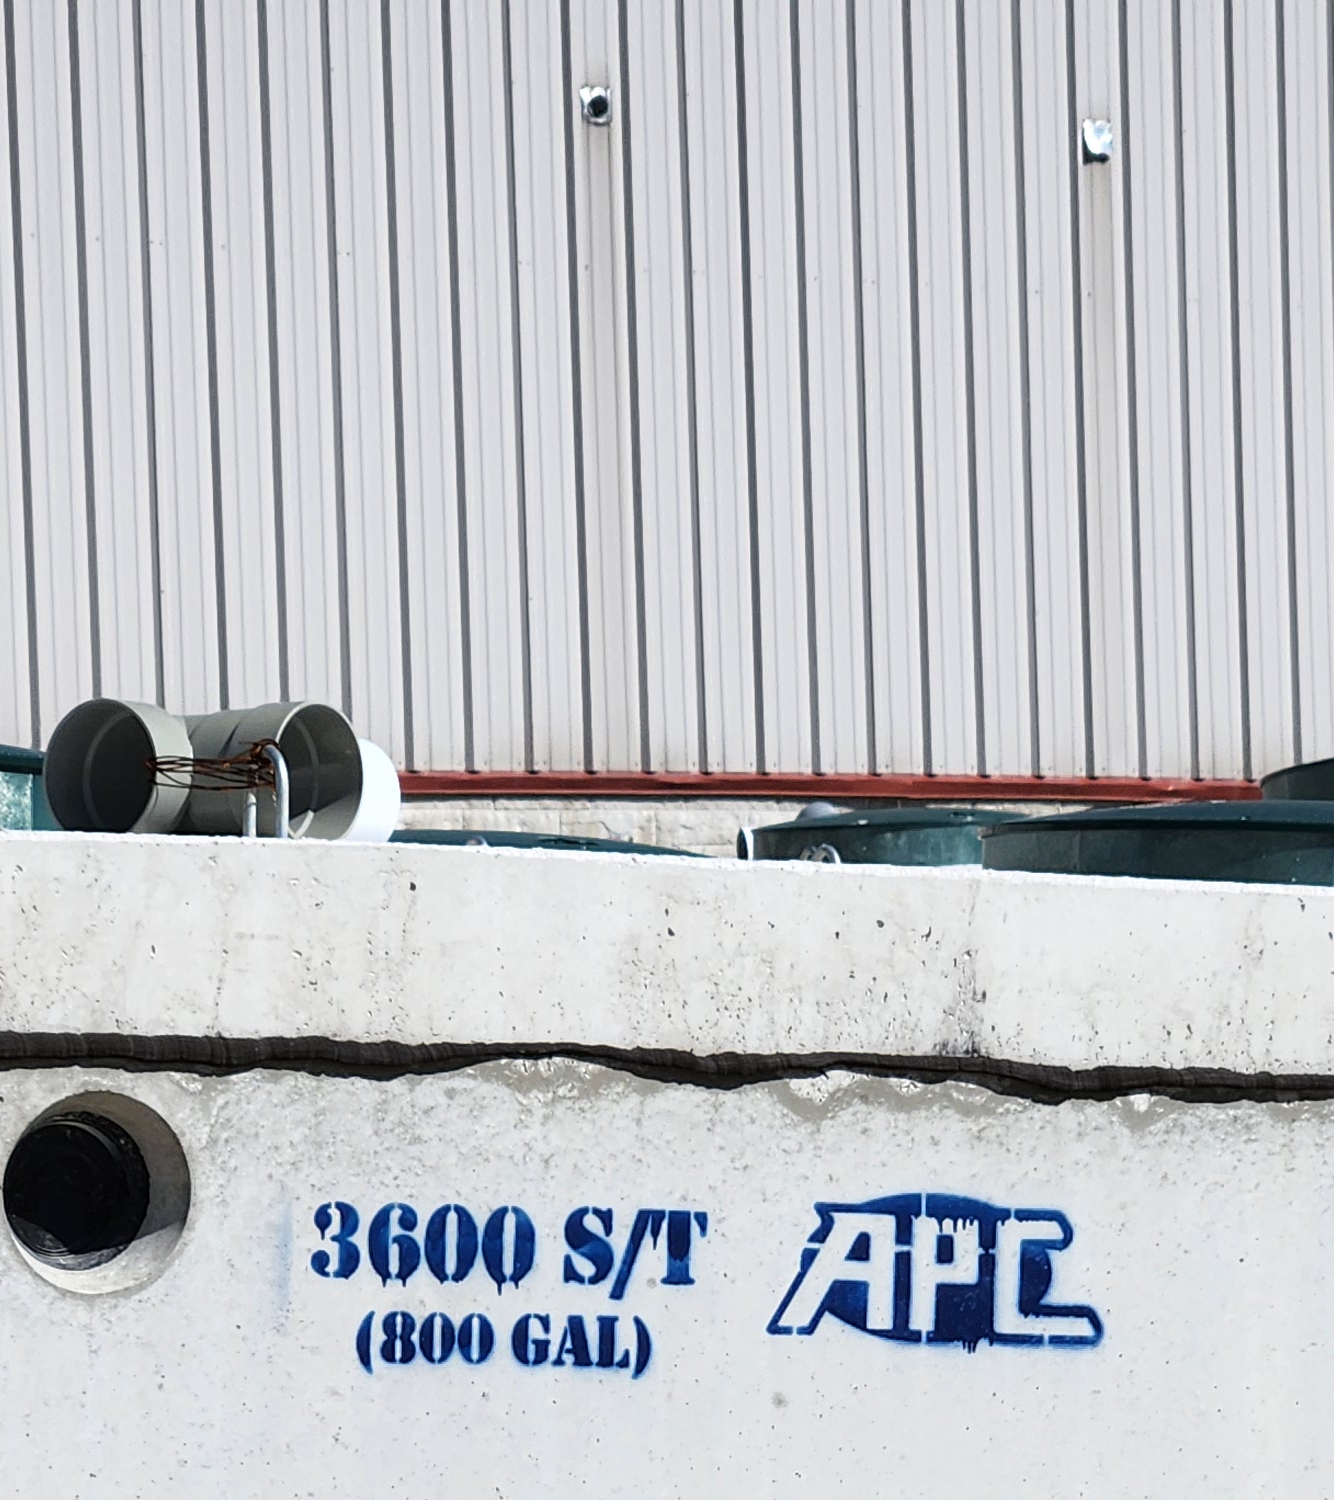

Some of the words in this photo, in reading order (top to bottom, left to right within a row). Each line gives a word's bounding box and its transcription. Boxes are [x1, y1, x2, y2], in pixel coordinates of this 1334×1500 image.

[309, 1201, 537, 1290] 3600
[563, 1206, 710, 1300] S/T
[766, 1193, 1105, 1350] APC
[355, 1310, 496, 1375] (800
[510, 1313, 654, 1380] GAL)
